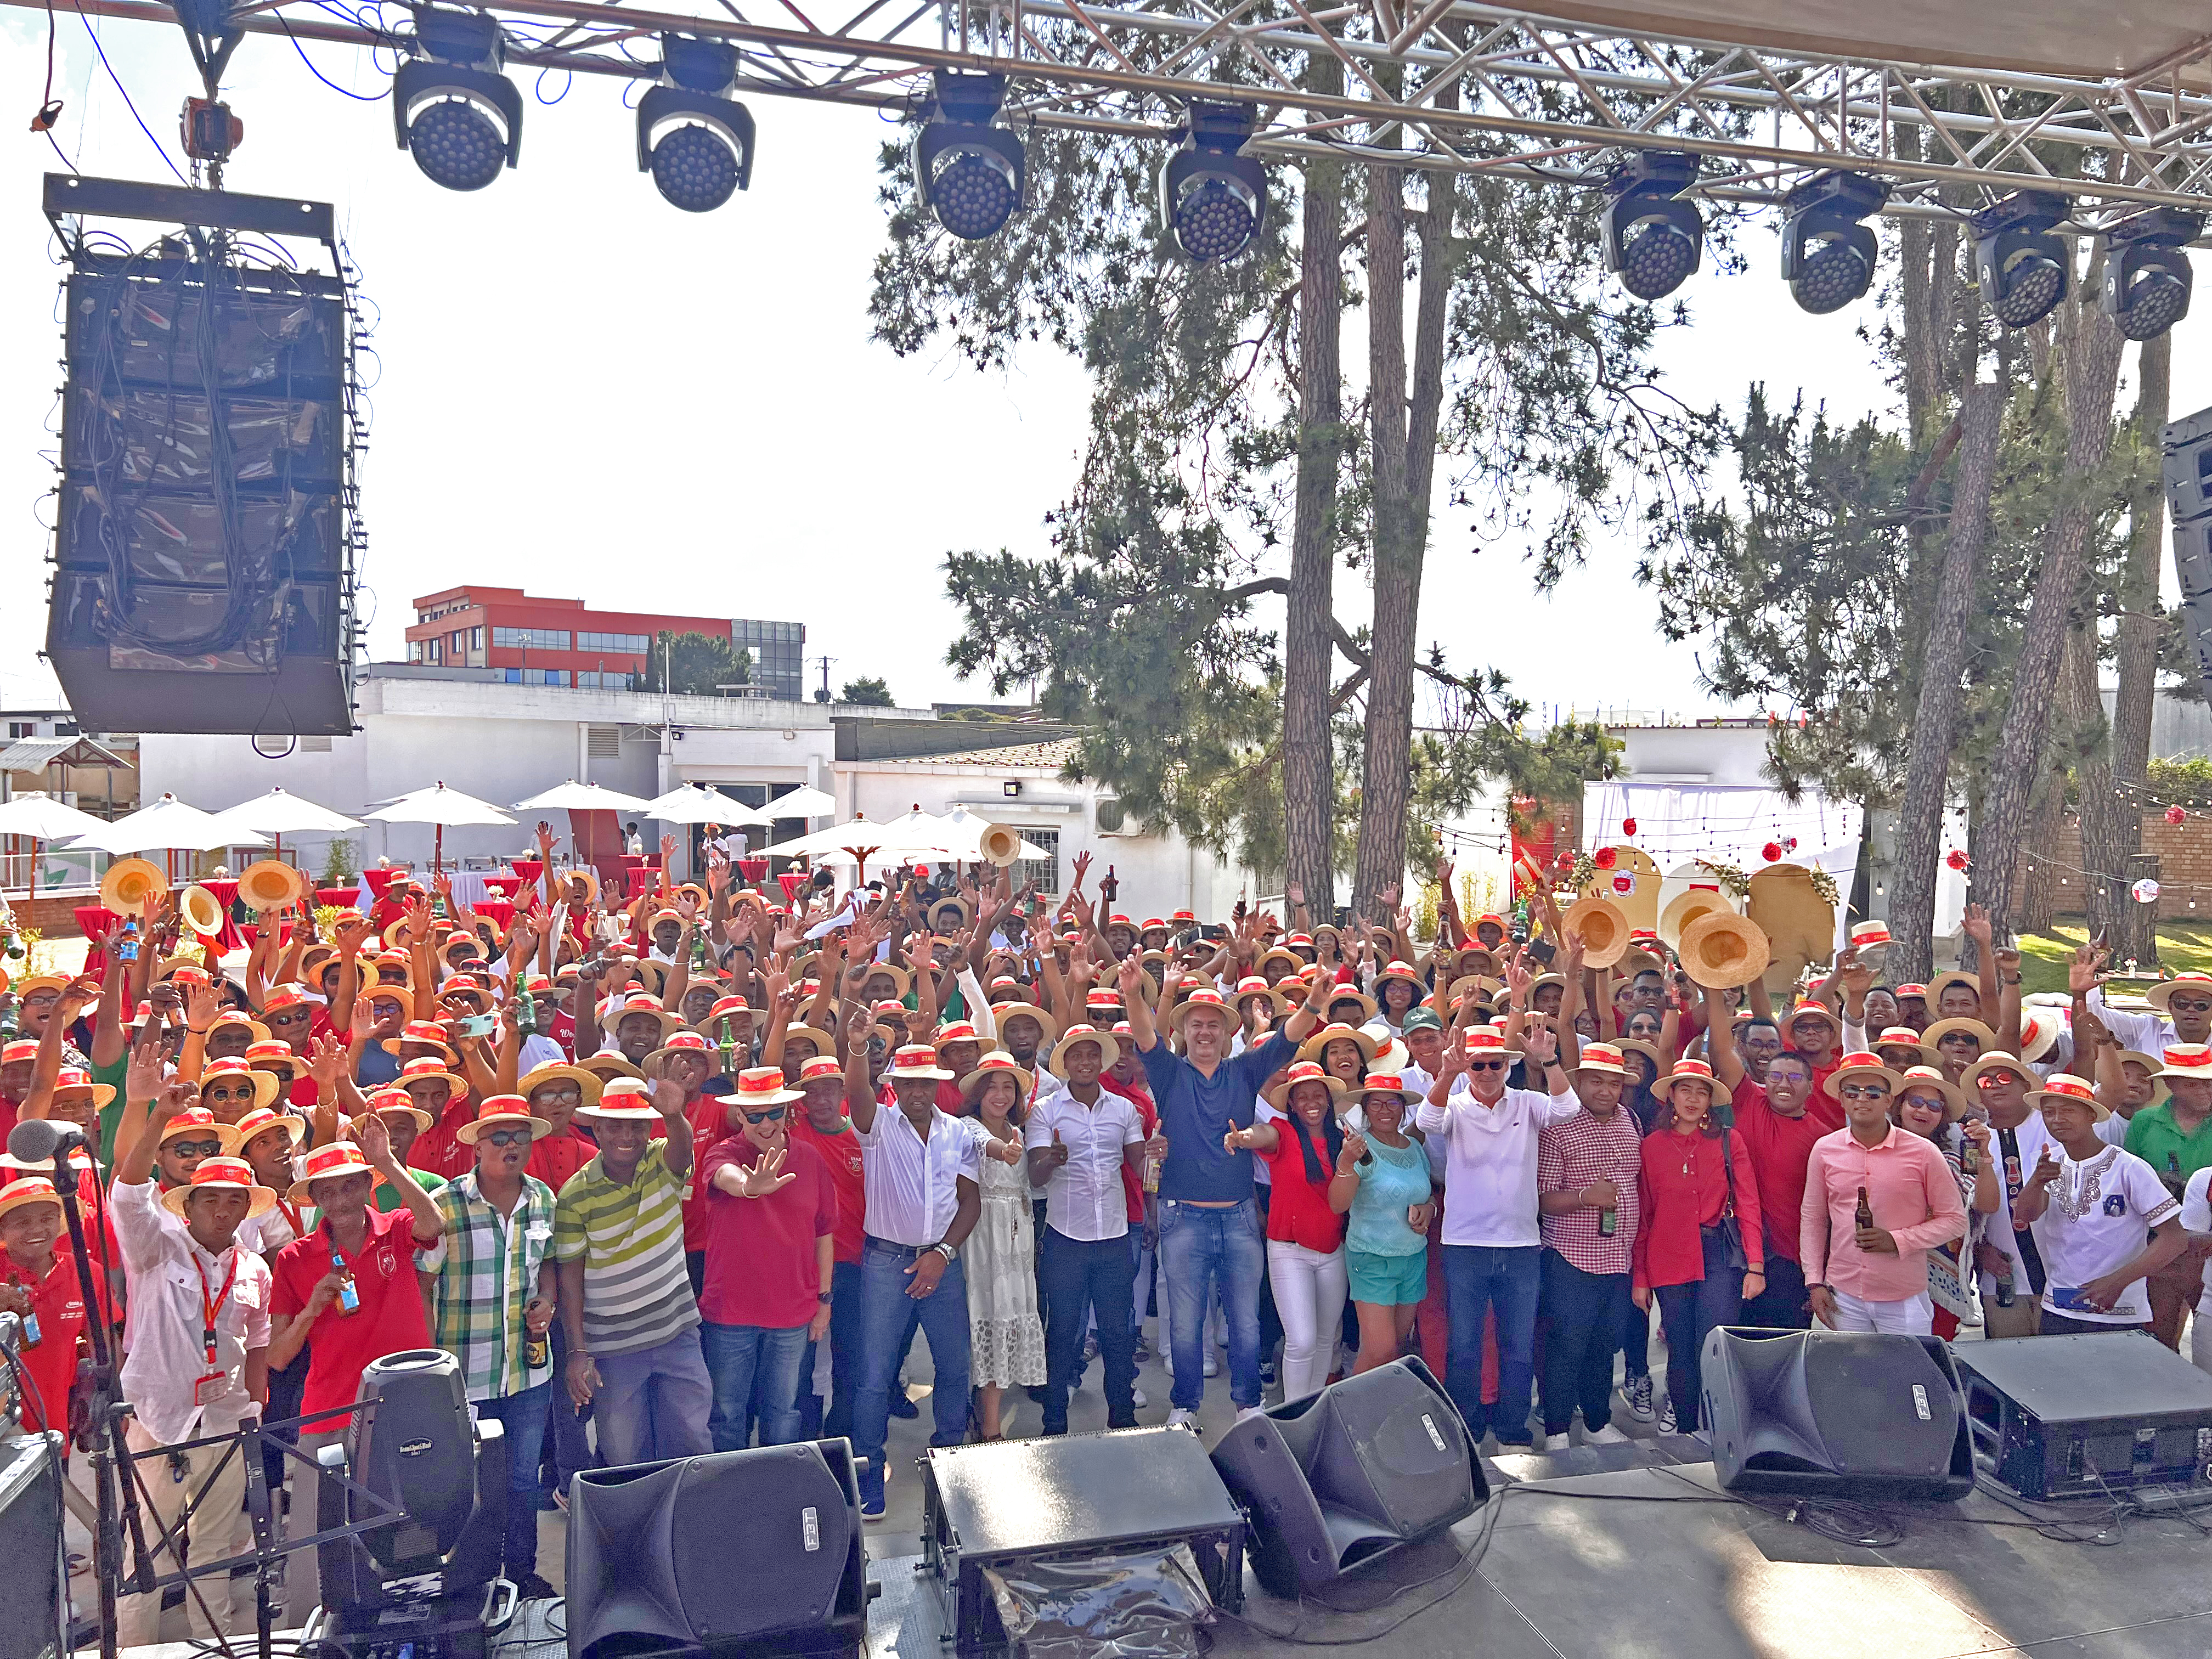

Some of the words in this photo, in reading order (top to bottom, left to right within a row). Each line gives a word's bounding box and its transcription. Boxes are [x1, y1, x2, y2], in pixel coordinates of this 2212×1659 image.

[1915, 1387, 1929, 1417] FBT
[1424, 1419, 1443, 1448] FBT
[804, 1512, 817, 1547] FBT
